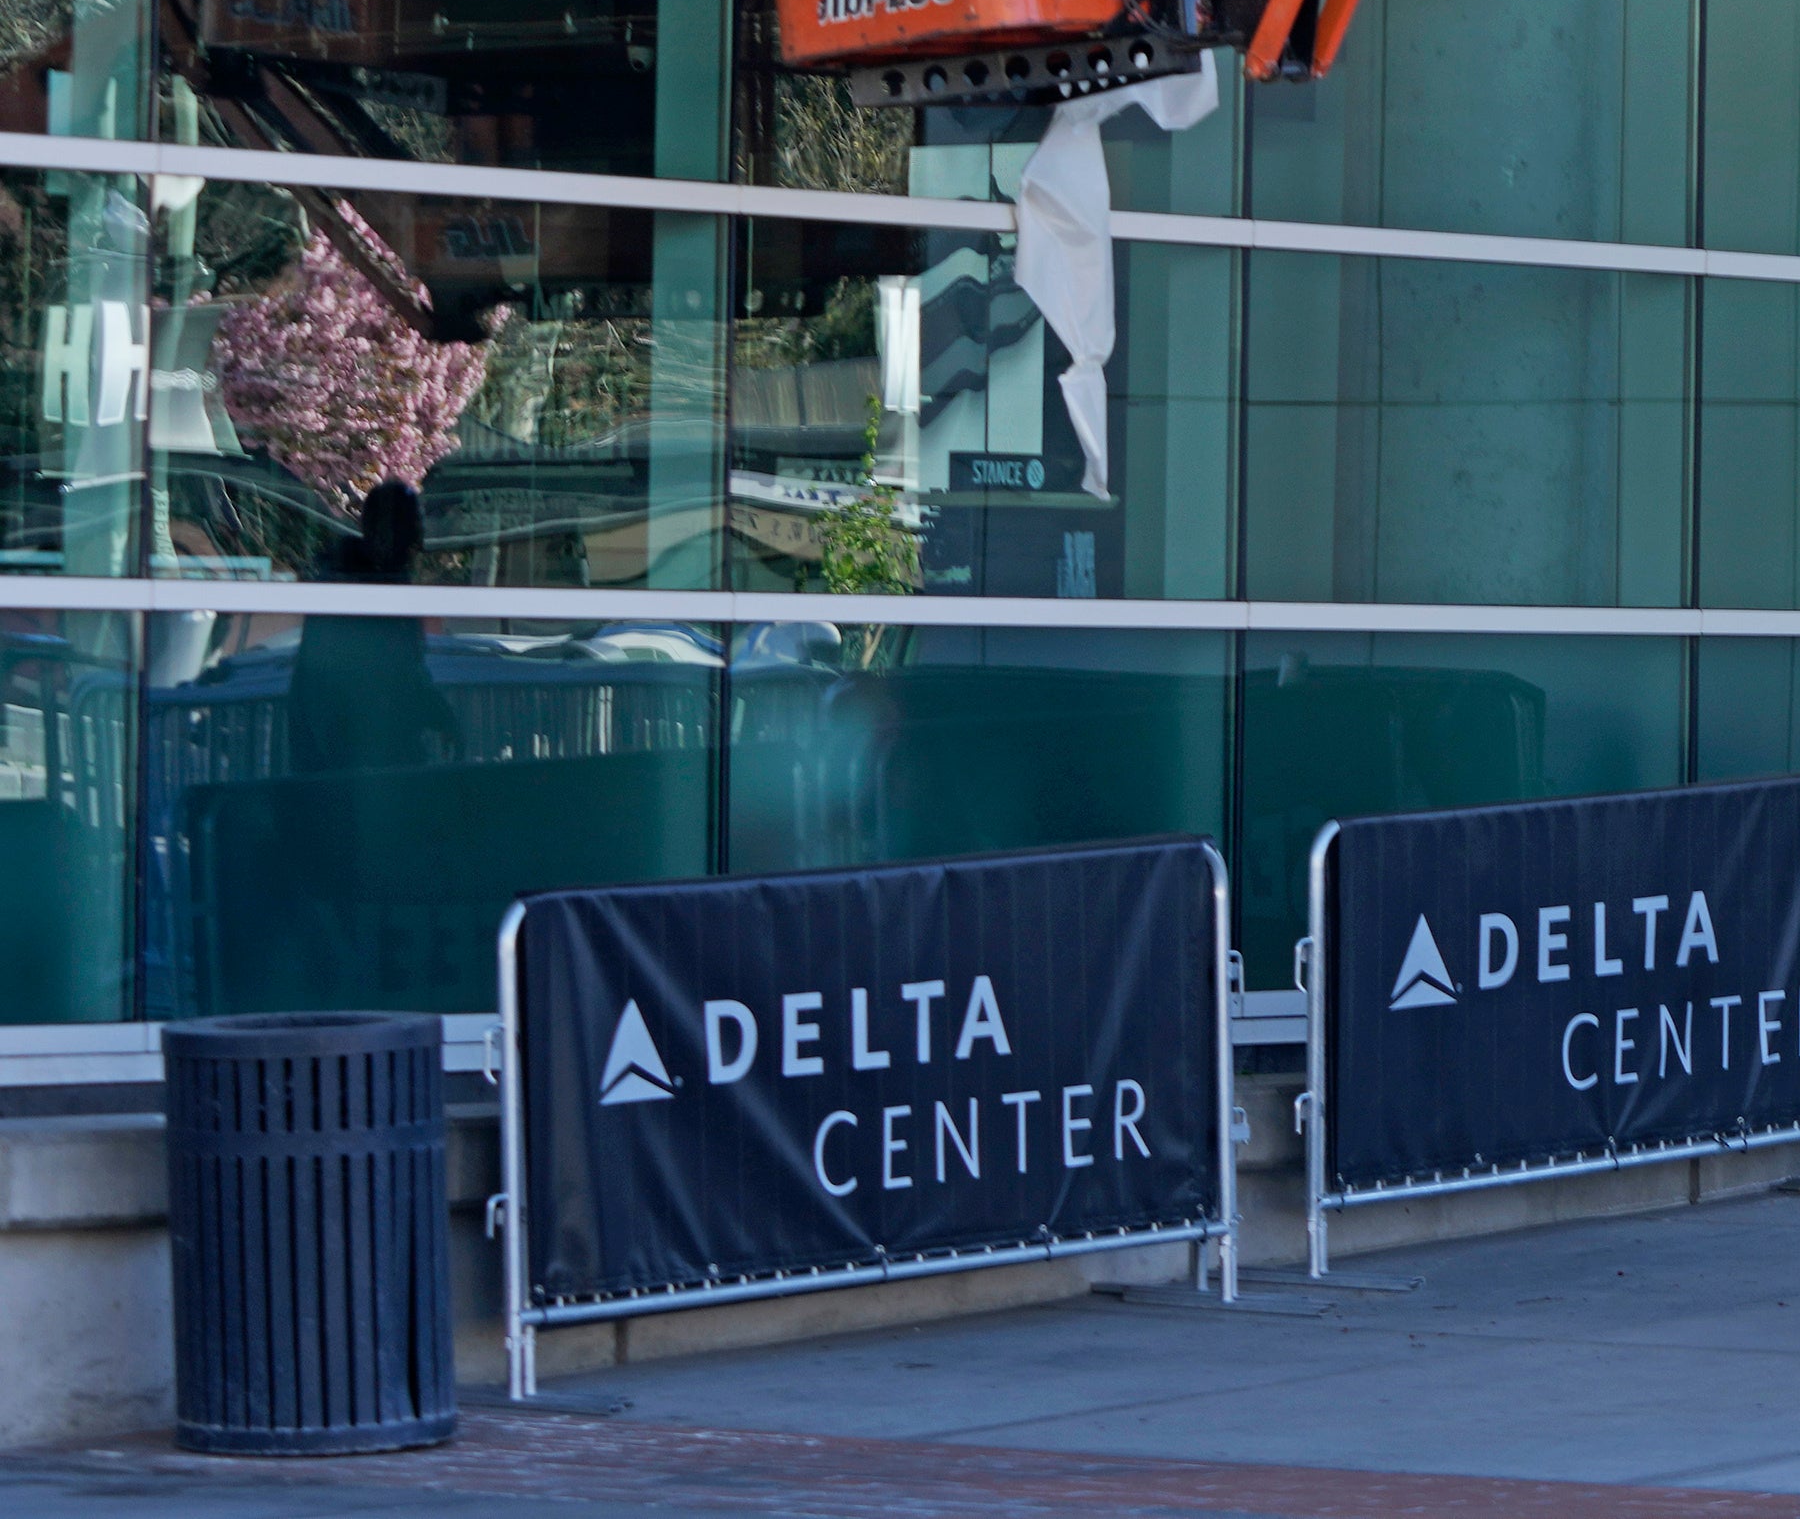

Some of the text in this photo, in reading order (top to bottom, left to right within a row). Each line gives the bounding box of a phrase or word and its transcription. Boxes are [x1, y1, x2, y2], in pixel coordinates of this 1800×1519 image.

[972, 459, 1025, 487] STANCE
[1477, 890, 1720, 991] DELTA
[703, 974, 1012, 1085] DELTA
[813, 1078, 1152, 1197] CENTER
